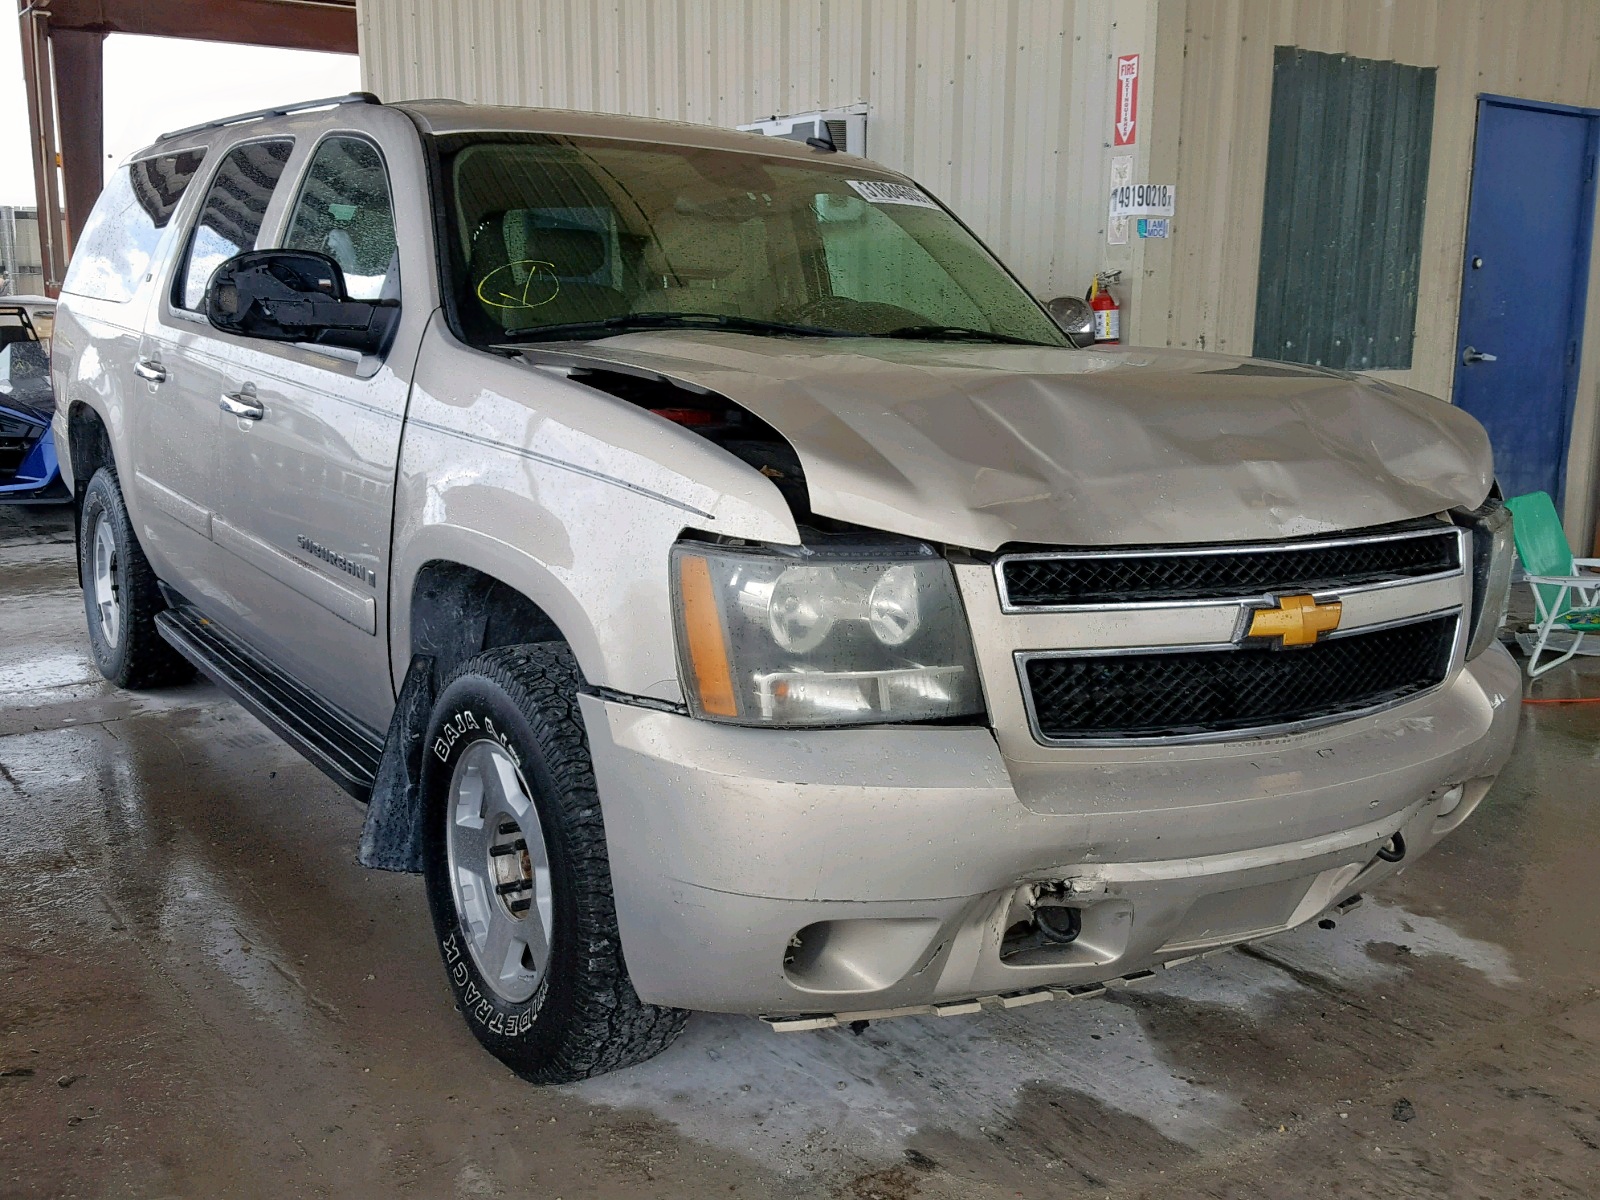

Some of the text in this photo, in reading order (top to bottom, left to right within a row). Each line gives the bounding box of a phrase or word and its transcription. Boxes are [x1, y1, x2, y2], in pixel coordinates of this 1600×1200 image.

[1121, 63, 1136, 76] FIRE
[297, 534, 366, 581] SUBURBAN
[433, 710, 480, 763] BAJA
[443, 932, 549, 1037] WIDETRACK
